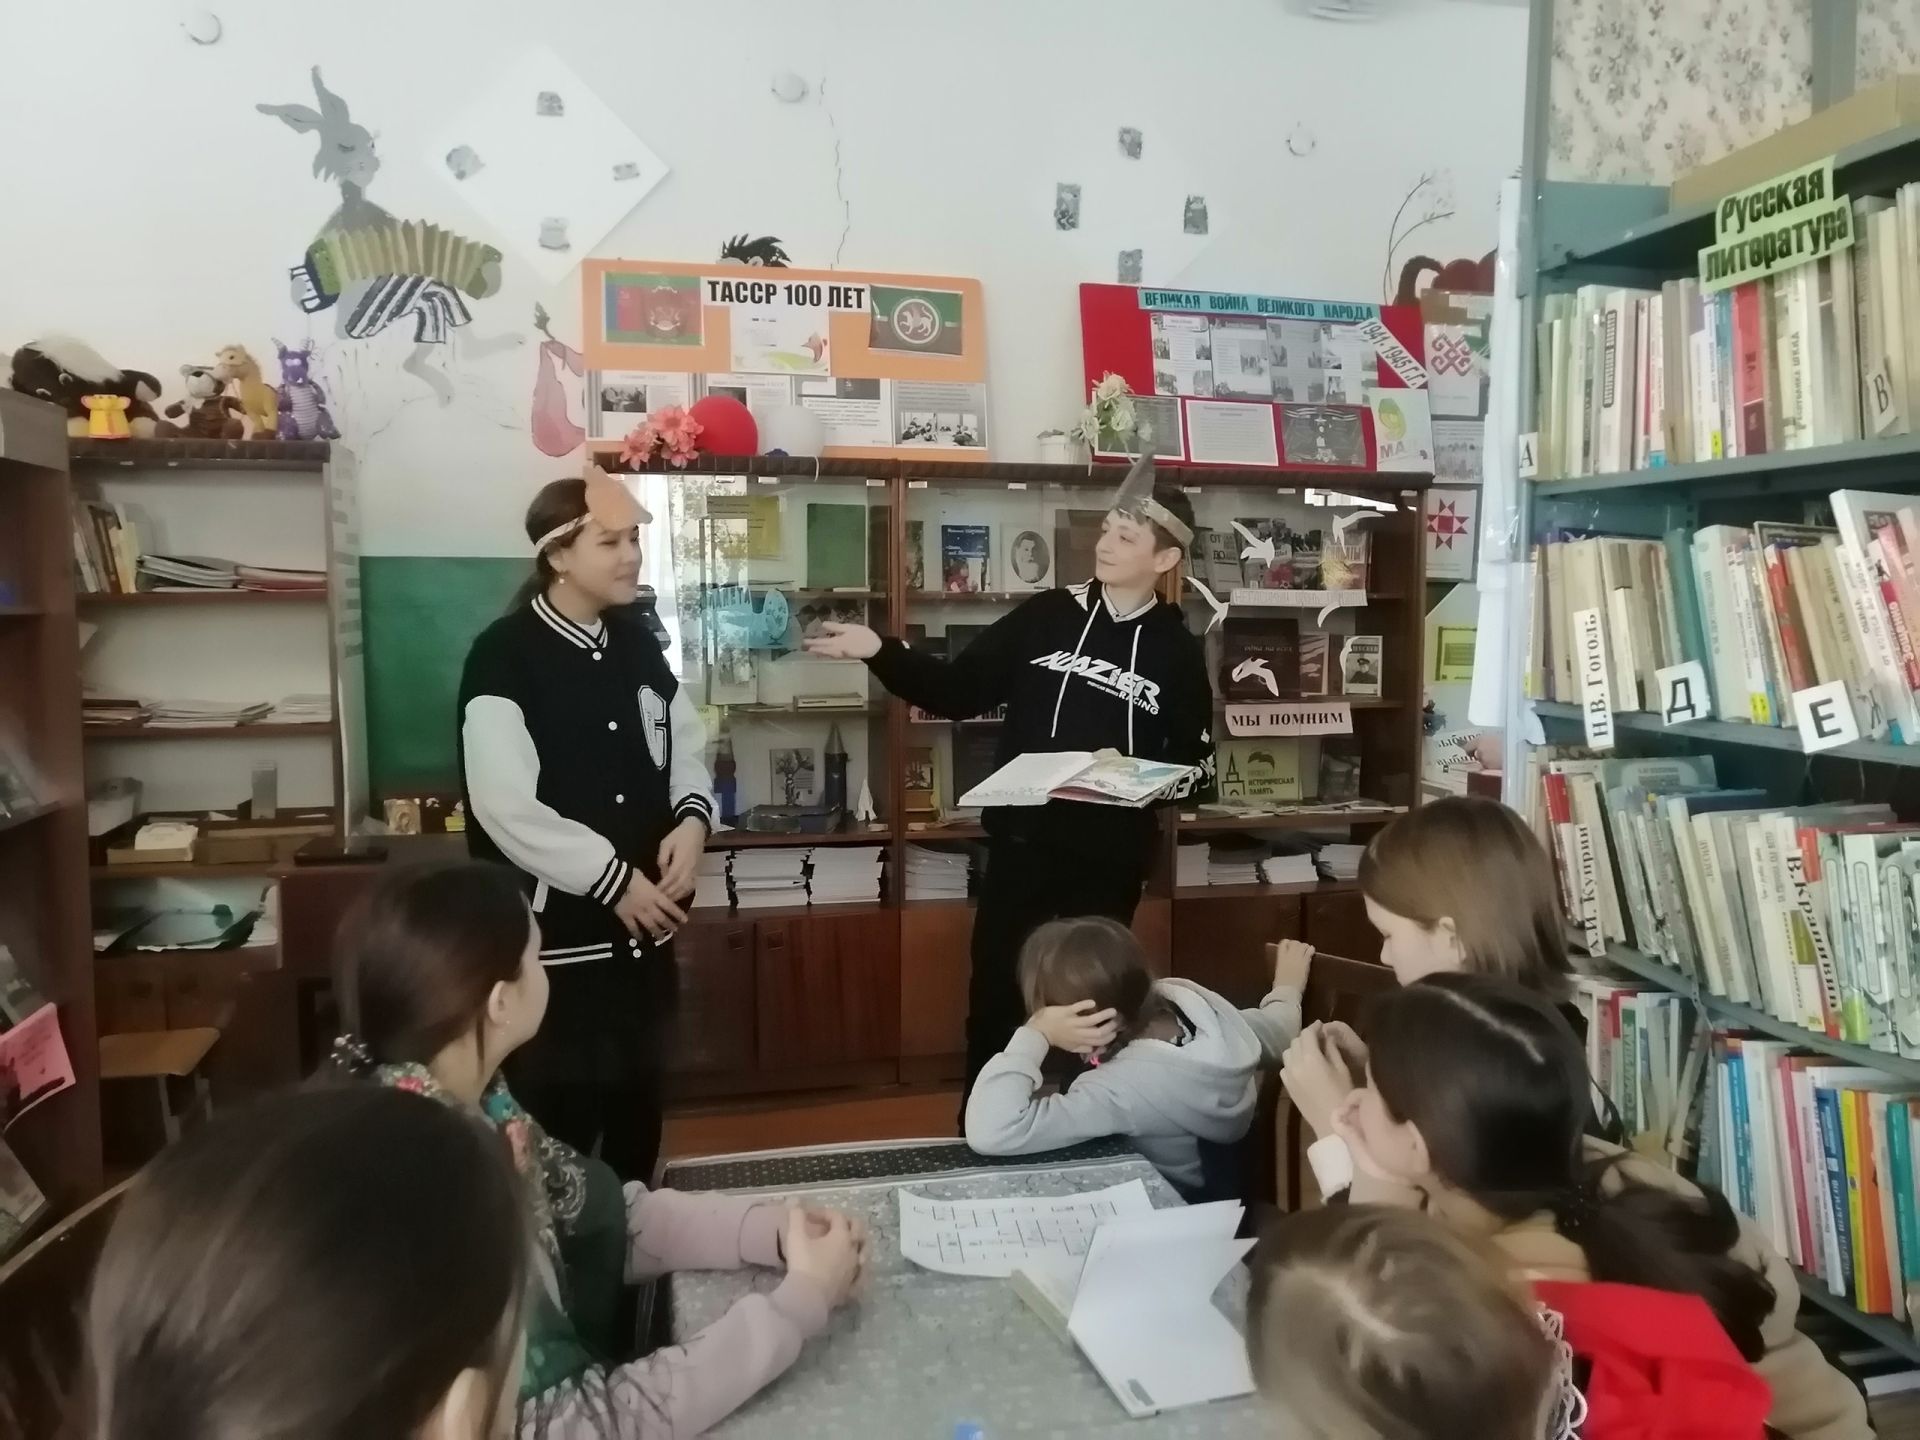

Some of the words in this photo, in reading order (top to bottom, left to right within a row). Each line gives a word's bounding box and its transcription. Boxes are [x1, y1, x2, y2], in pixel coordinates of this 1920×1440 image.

[1721, 167, 1825, 233] Русская
[1705, 205, 1848, 282] литература
[708, 280, 777, 305] ТАССР
[783, 284, 822, 307] 100
[828, 287, 865, 309] ЛЕТ
[1145, 292, 1201, 308] ВЕЛИКАЯ
[1209, 295, 1249, 311] ВОЙНА
[1257, 298, 1315, 317] ВЕЛИКОГО
[1323, 302, 1374, 321] НАРОДА
[1874, 380, 1889, 414] В
[1520, 442, 1533, 468] А
[1585, 613, 1602, 686] Гоголь
[1232, 712, 1260, 726] МЫ
[1270, 711, 1344, 726] ПОМНИМ
[1667, 677, 1696, 723] Д
[1809, 698, 1842, 738] Е
[1577, 826, 1598, 902] Куприн
